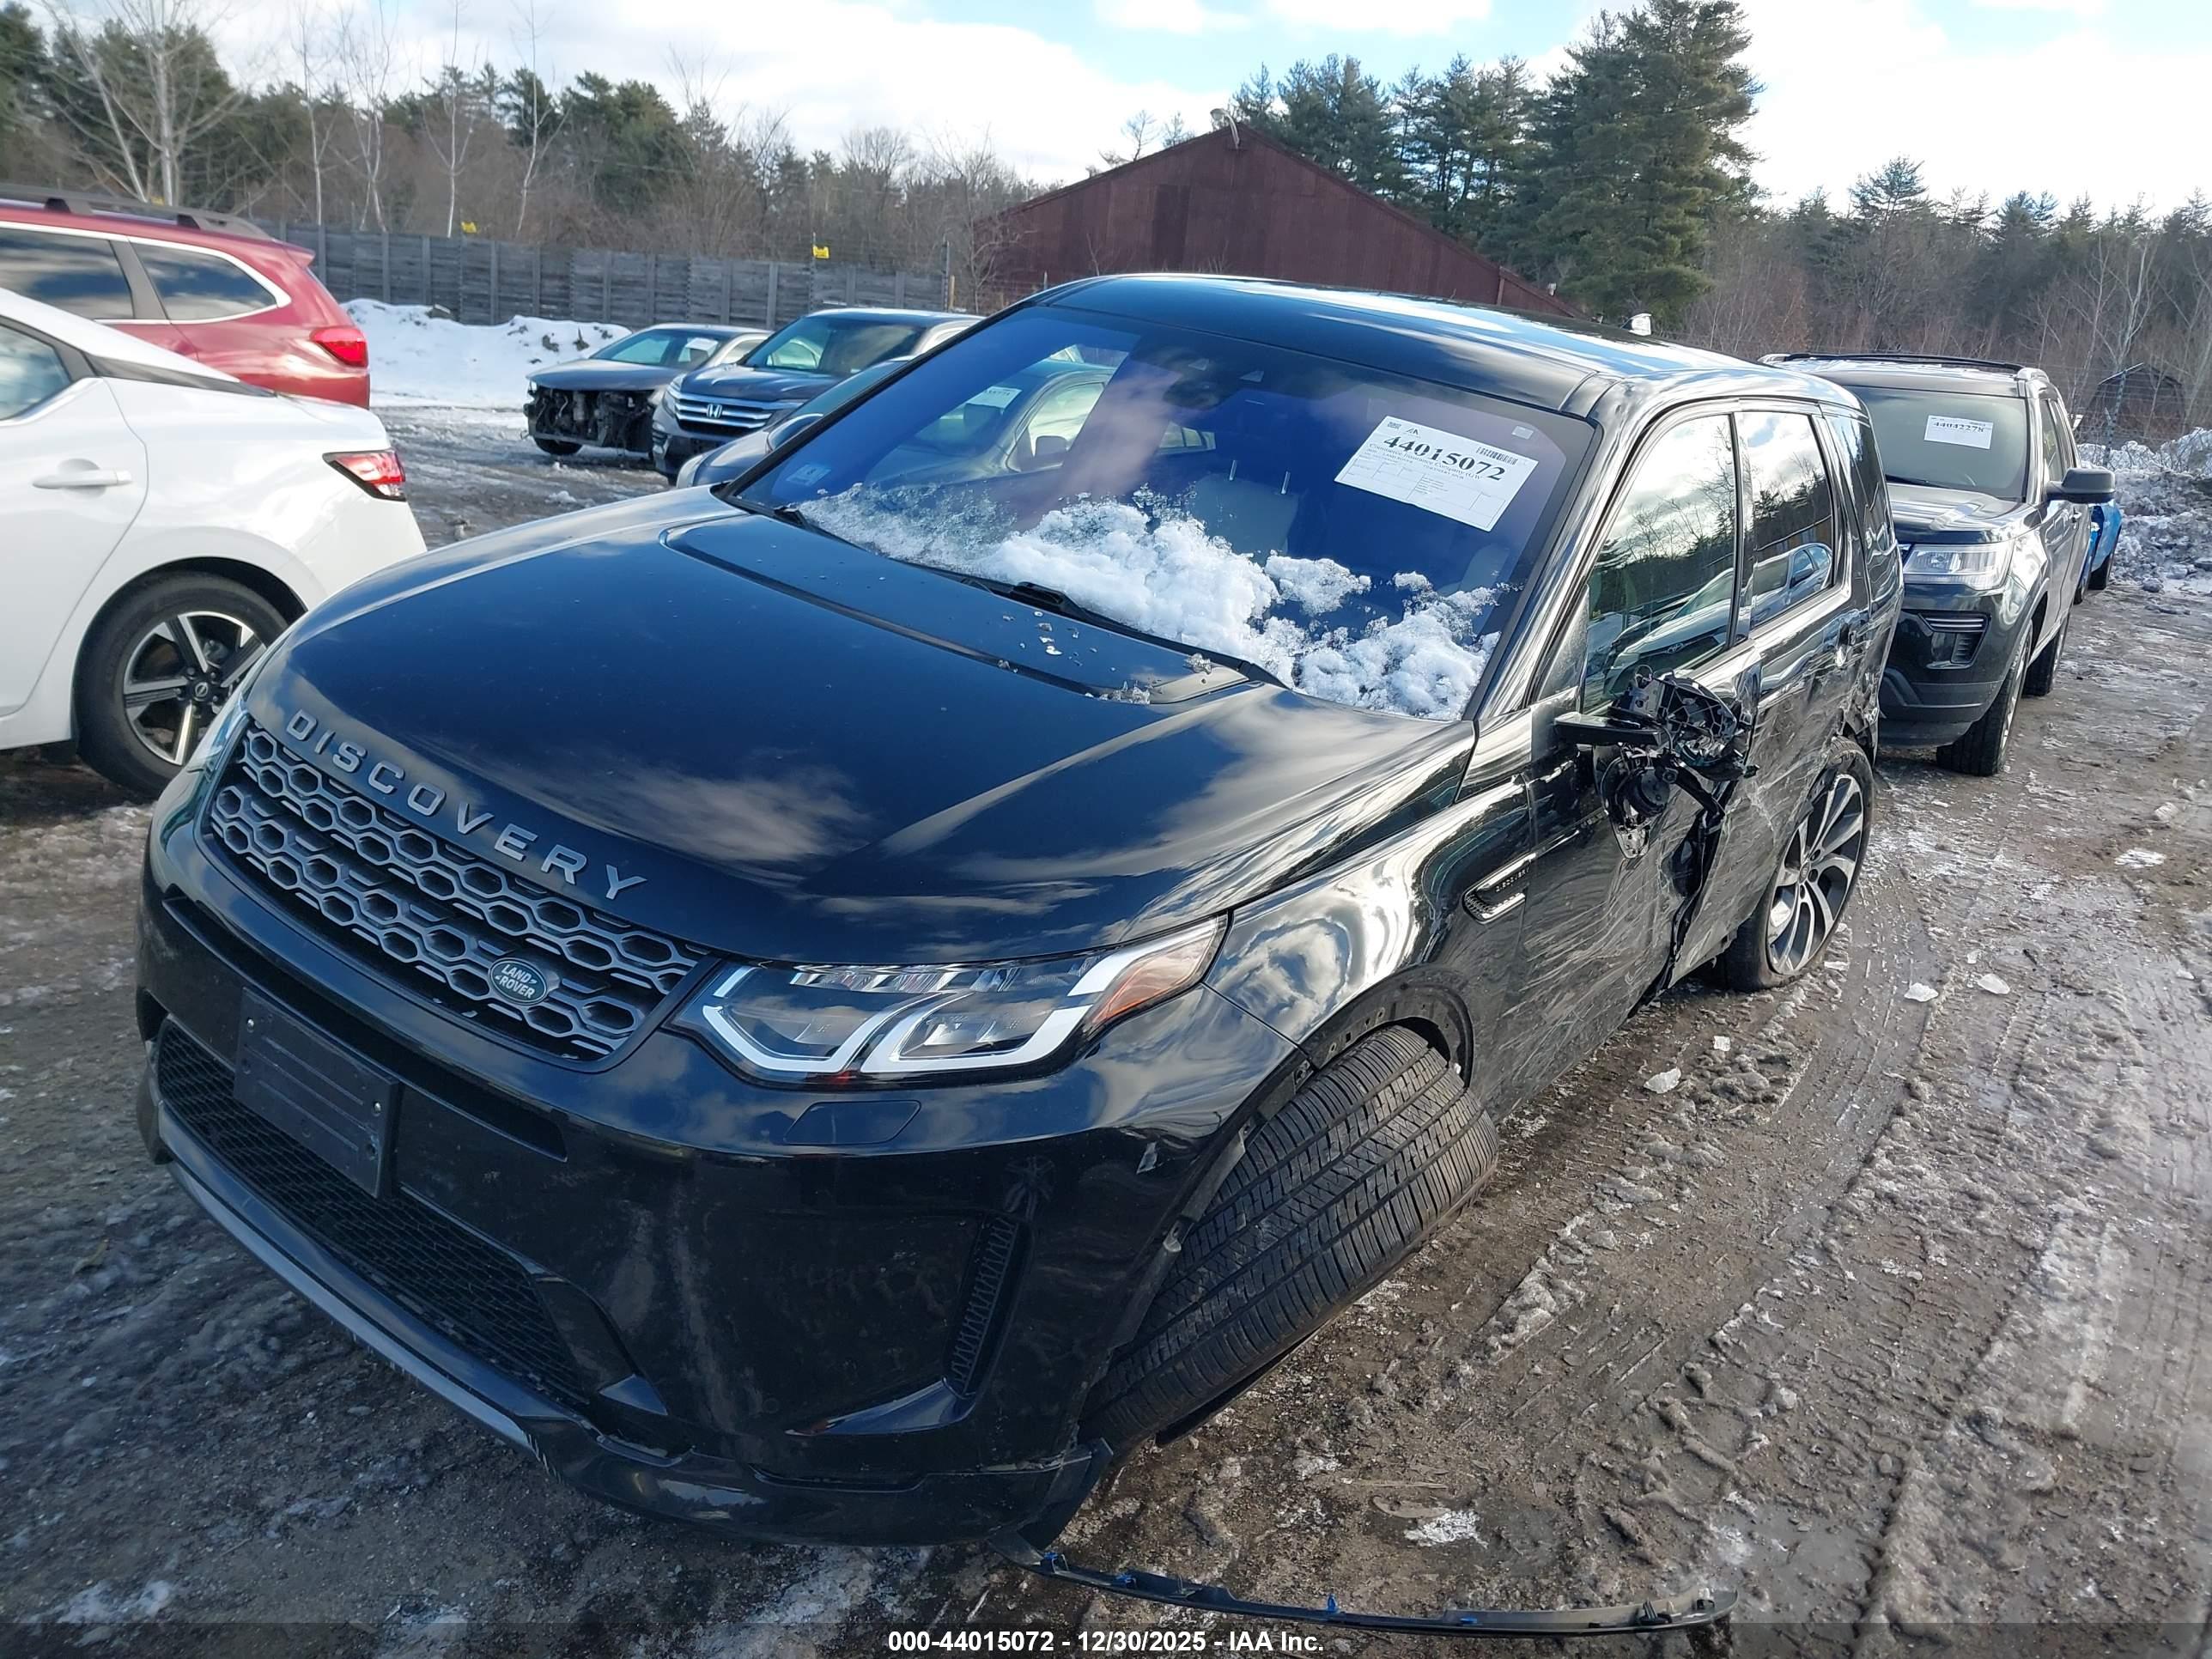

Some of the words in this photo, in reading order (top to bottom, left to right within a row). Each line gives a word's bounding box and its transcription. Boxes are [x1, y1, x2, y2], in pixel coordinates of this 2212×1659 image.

[1383, 436, 1505, 481] 44015072
[286, 709, 647, 900] DISCOVERY
[499, 975, 536, 999] ROVER
[501, 964, 532, 983] LAND
